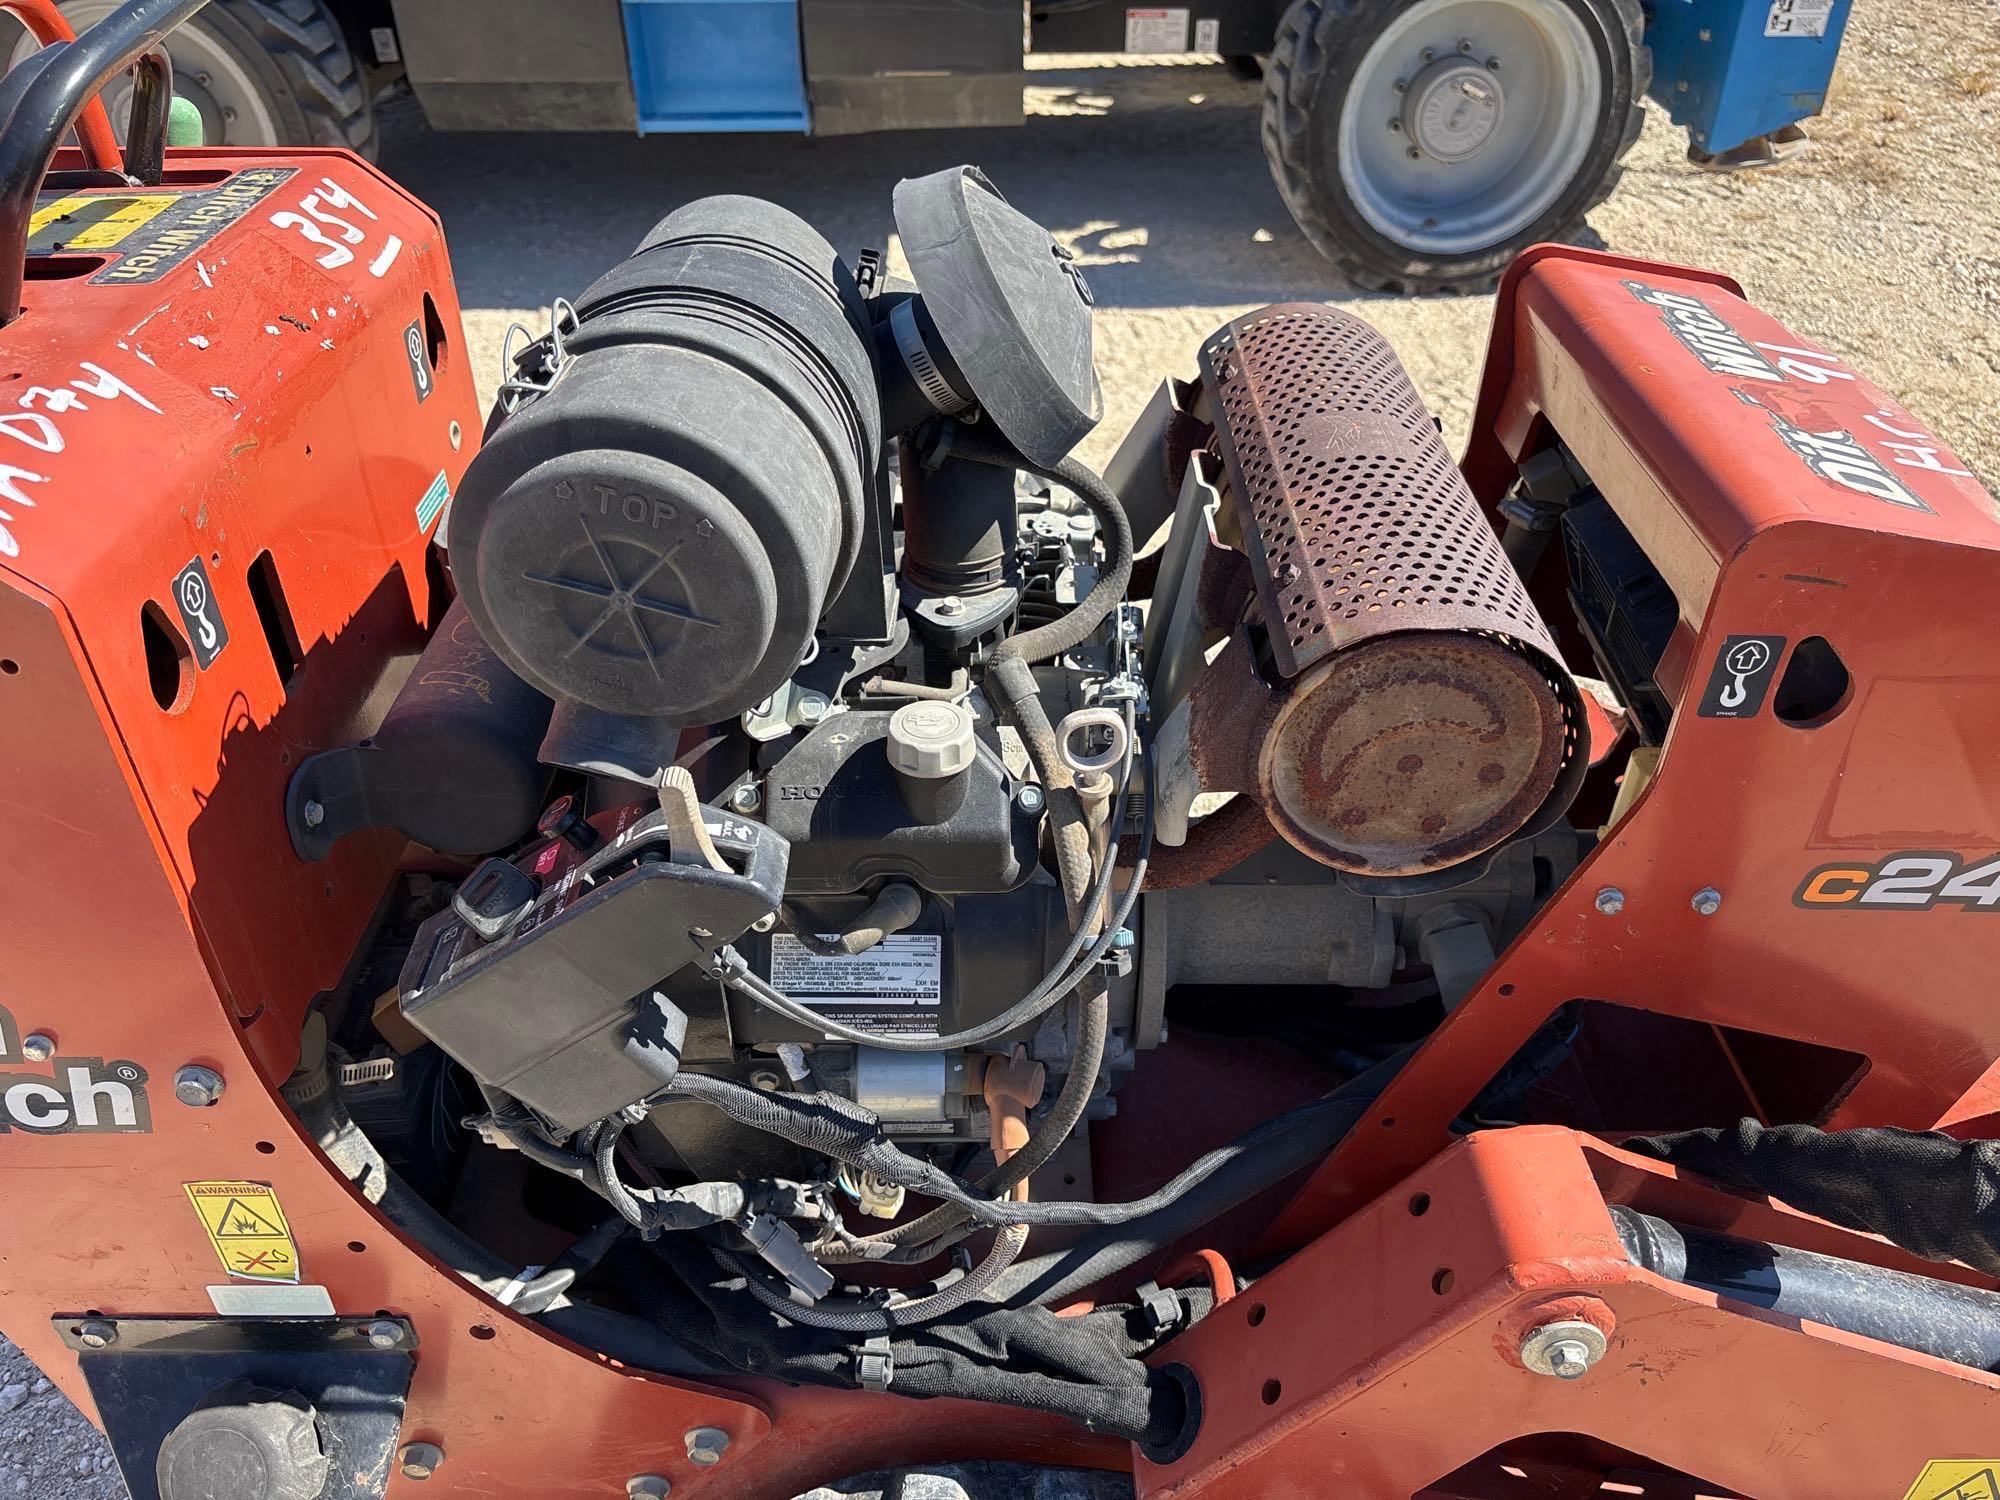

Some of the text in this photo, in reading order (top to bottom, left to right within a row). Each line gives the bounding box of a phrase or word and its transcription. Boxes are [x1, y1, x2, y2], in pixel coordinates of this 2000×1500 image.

[109, 182, 266, 279] Ditch Witch
[268, 176, 379, 270] 354
[1640, 289, 1789, 383] Witch
[593, 483, 679, 529] TOP
[615, 806, 629, 832] CHOKE
[206, 1186, 266, 1194] WARNING
[249, 1289, 321, 1297] UNLEADED
[255, 1304, 289, 1312] ONLY
